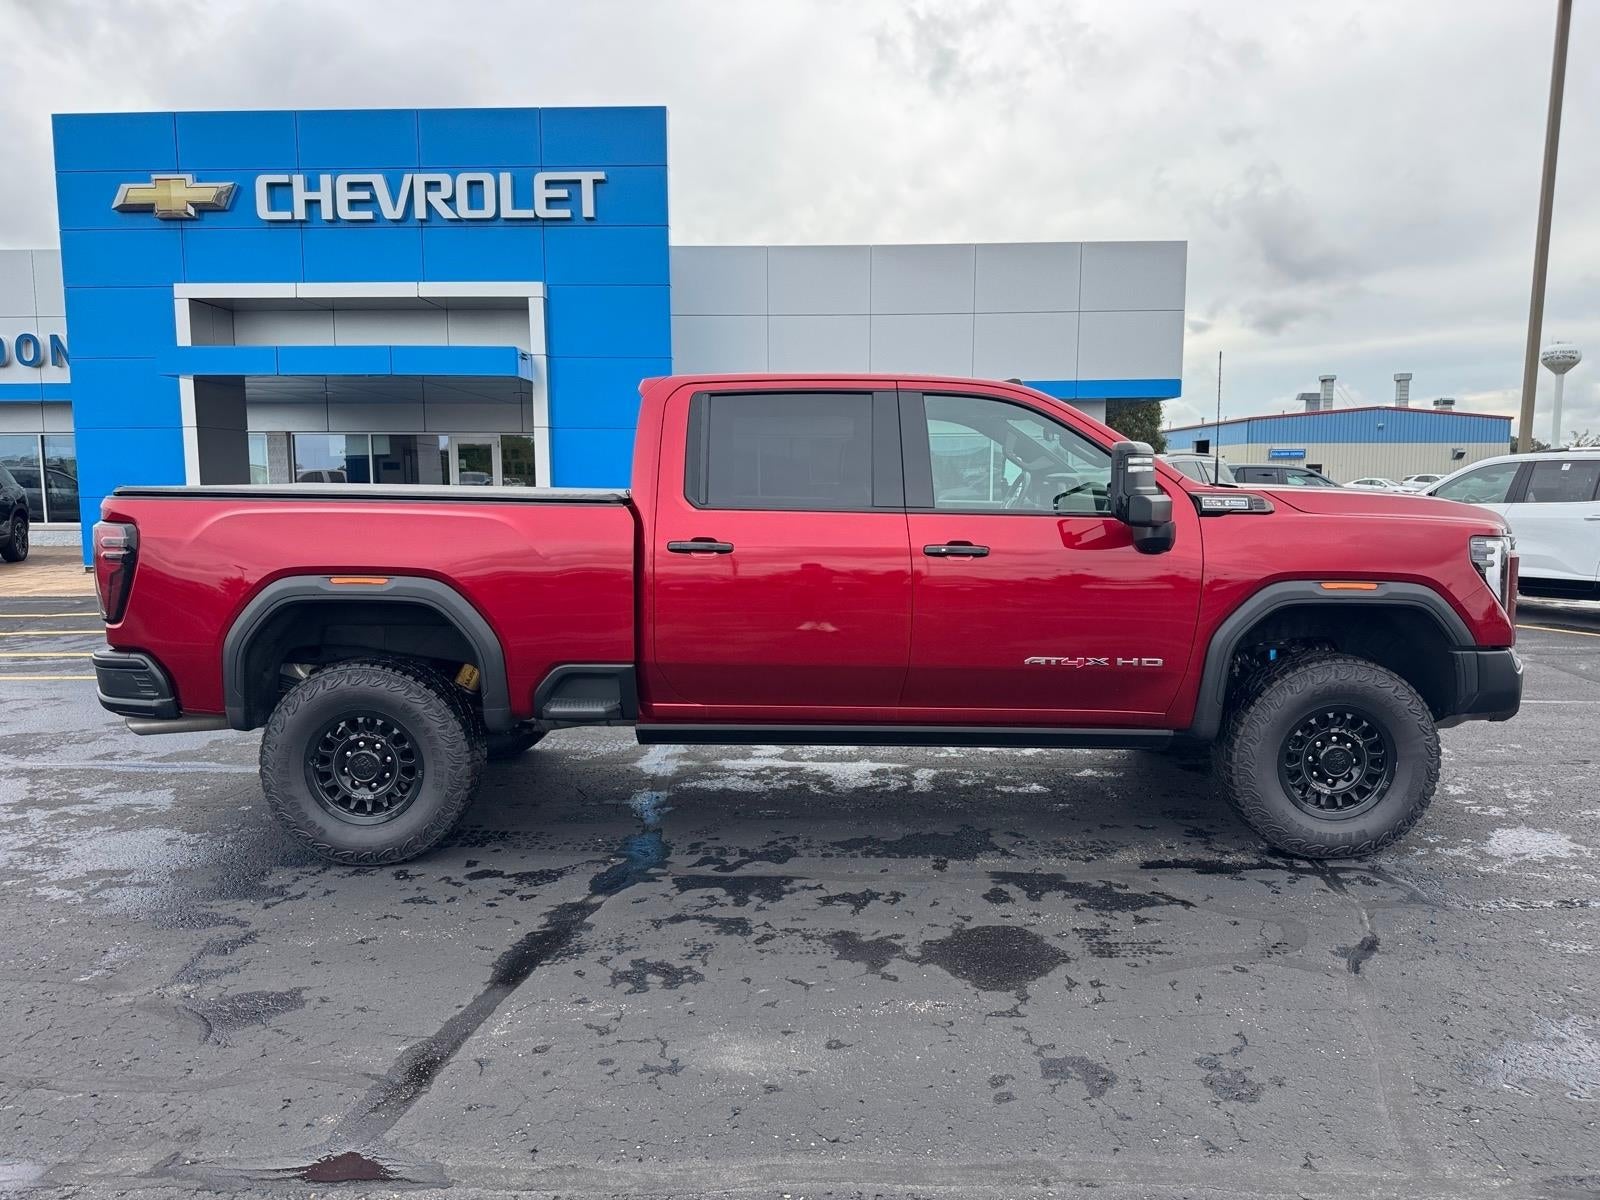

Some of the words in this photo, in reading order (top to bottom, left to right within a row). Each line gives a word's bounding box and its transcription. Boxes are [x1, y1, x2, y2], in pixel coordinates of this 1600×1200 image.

[255, 171, 606, 221] CHEVROLET
[0, 333, 69, 368] ON
[1117, 657, 1163, 667] HD
